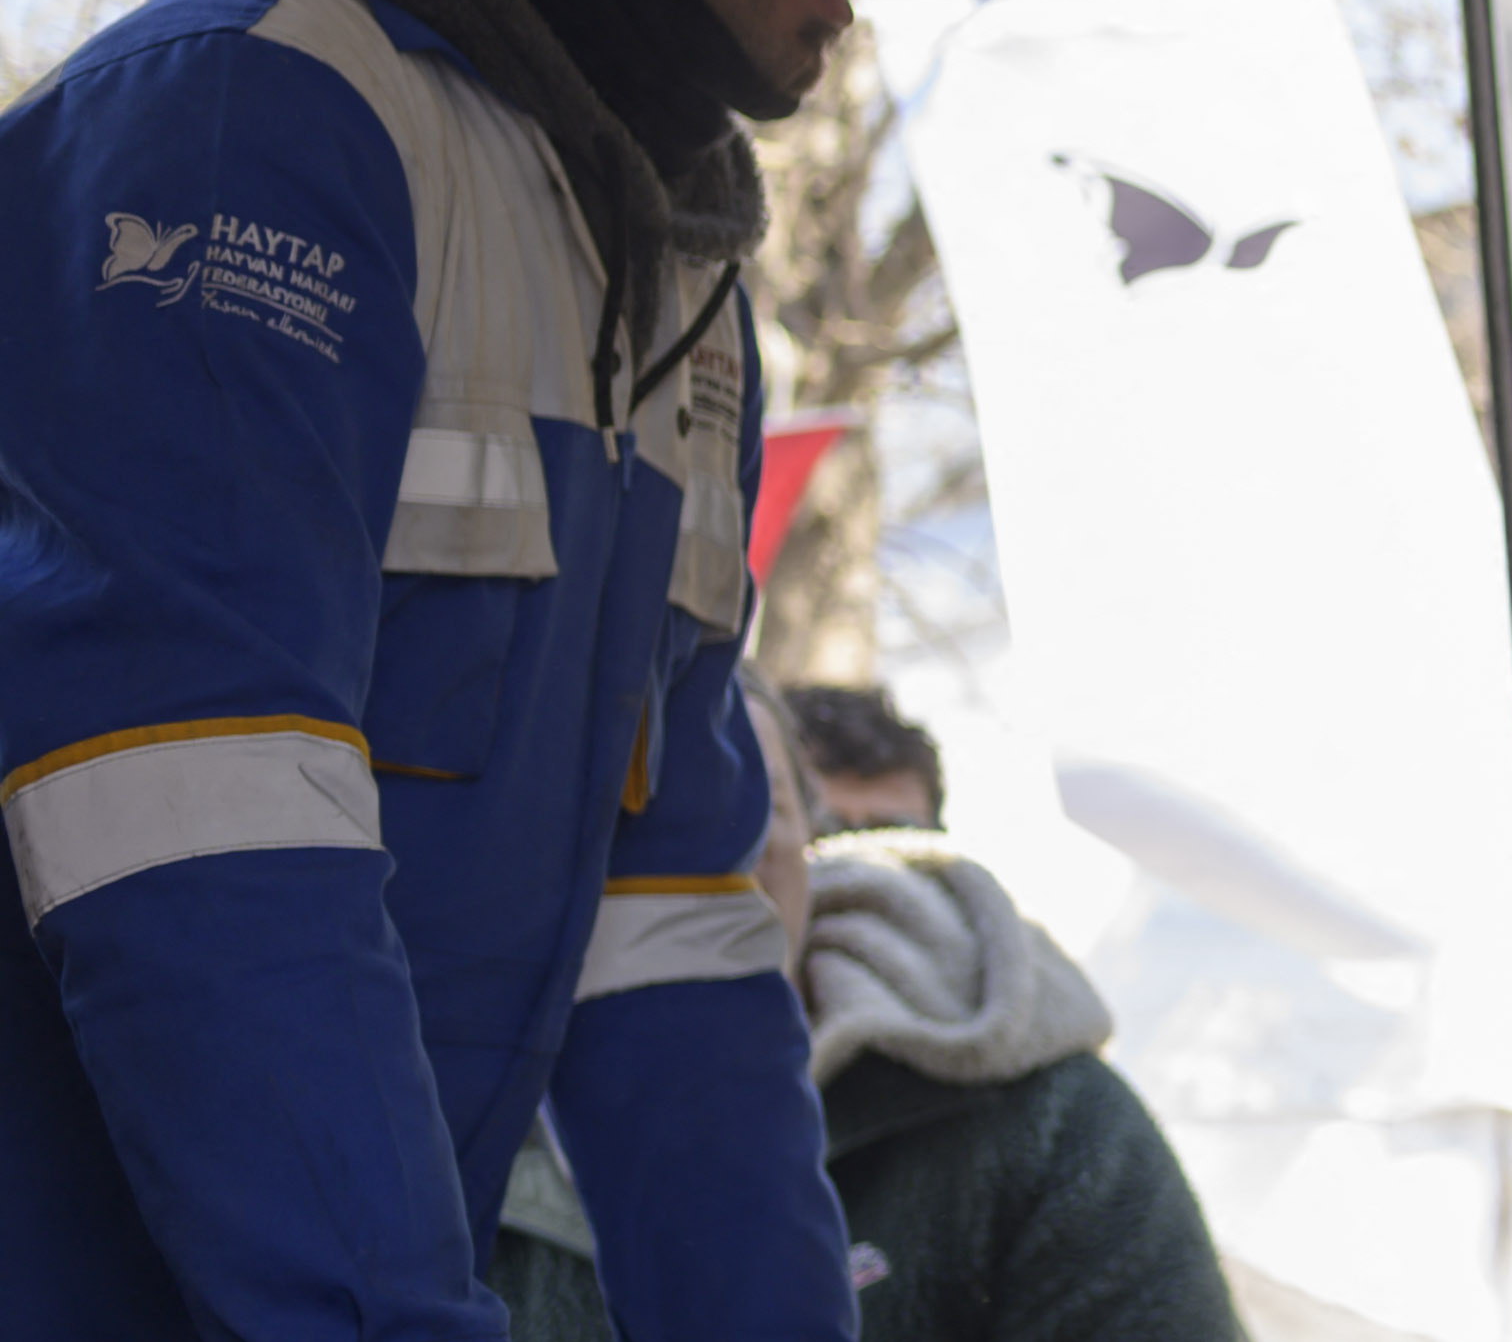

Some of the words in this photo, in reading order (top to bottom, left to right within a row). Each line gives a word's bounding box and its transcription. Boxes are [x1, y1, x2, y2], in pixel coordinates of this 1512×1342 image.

[210, 213, 346, 279] HAYTAP
[201, 266, 328, 322] FEDERASYONU
[205, 245, 284, 281] HAYVAN
[289, 269, 356, 314] HAKLARI
